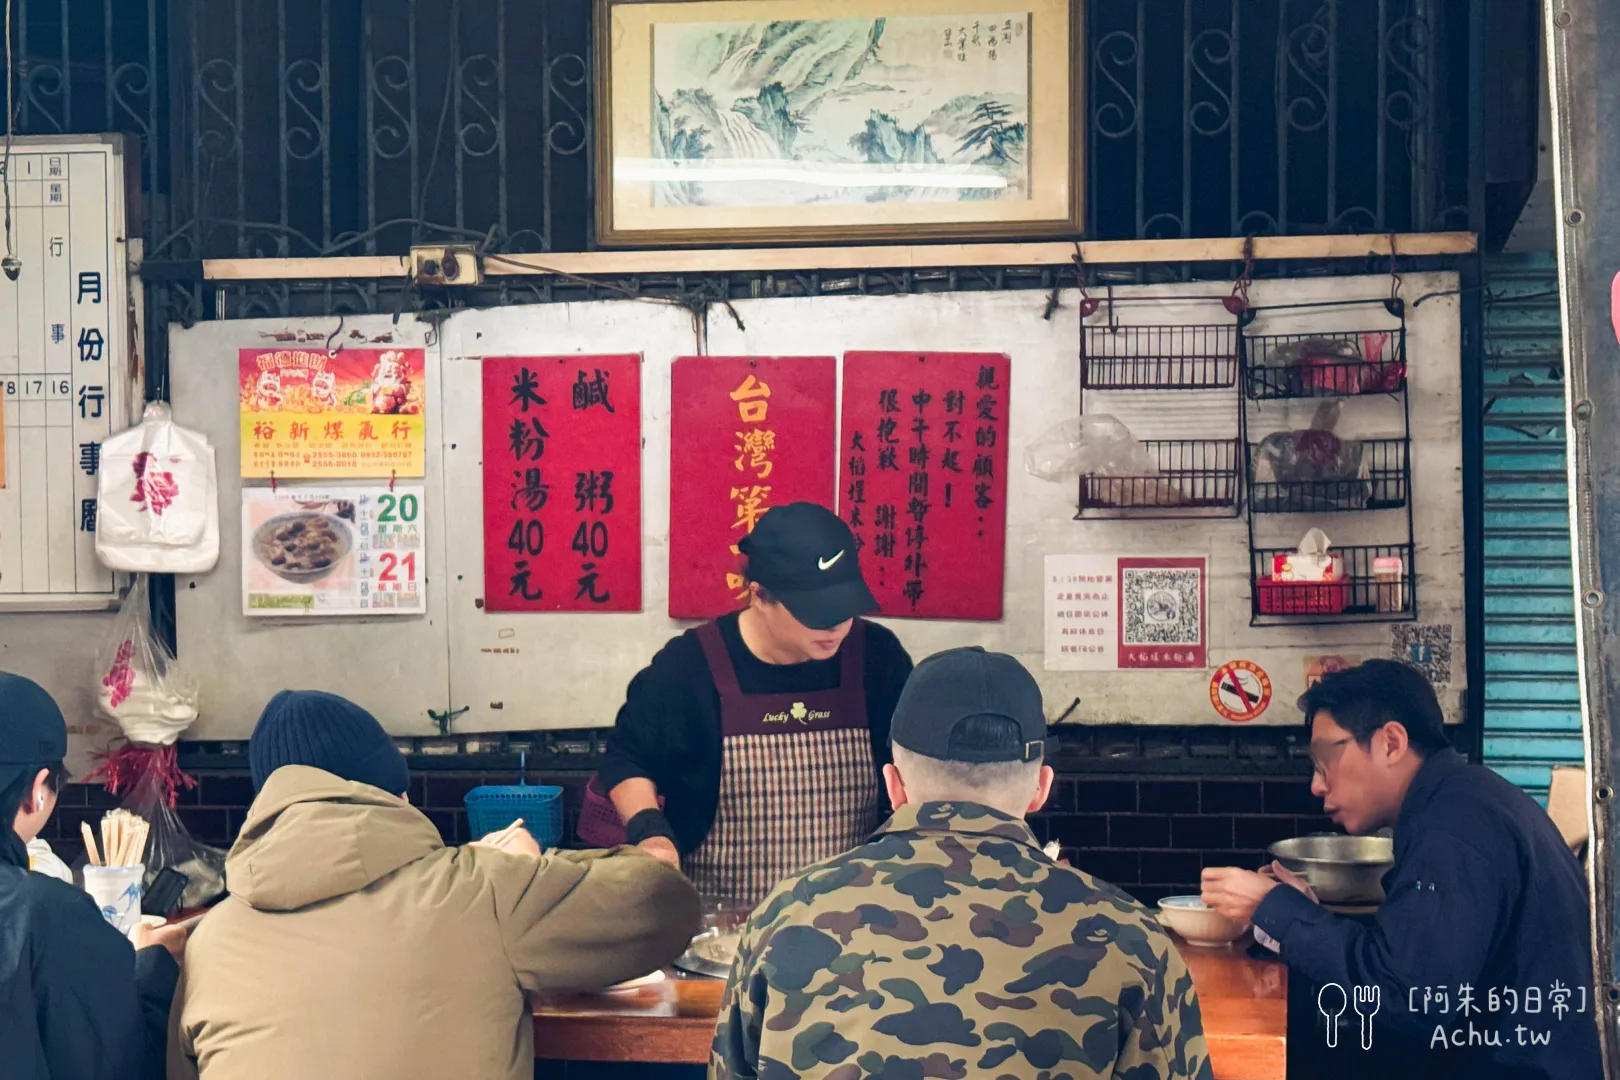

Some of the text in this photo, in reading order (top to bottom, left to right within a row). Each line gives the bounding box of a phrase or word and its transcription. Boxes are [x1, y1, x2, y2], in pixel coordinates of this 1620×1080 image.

[26, 381, 42, 394] 17
[52, 381, 69, 395] 16
[876, 388, 901, 472] 很抱歉
[726, 374, 776, 600] 台灣第
[377, 494, 418, 522] 20
[379, 552, 416, 581] 21
[763, 709, 831, 723] Lucky Grass
